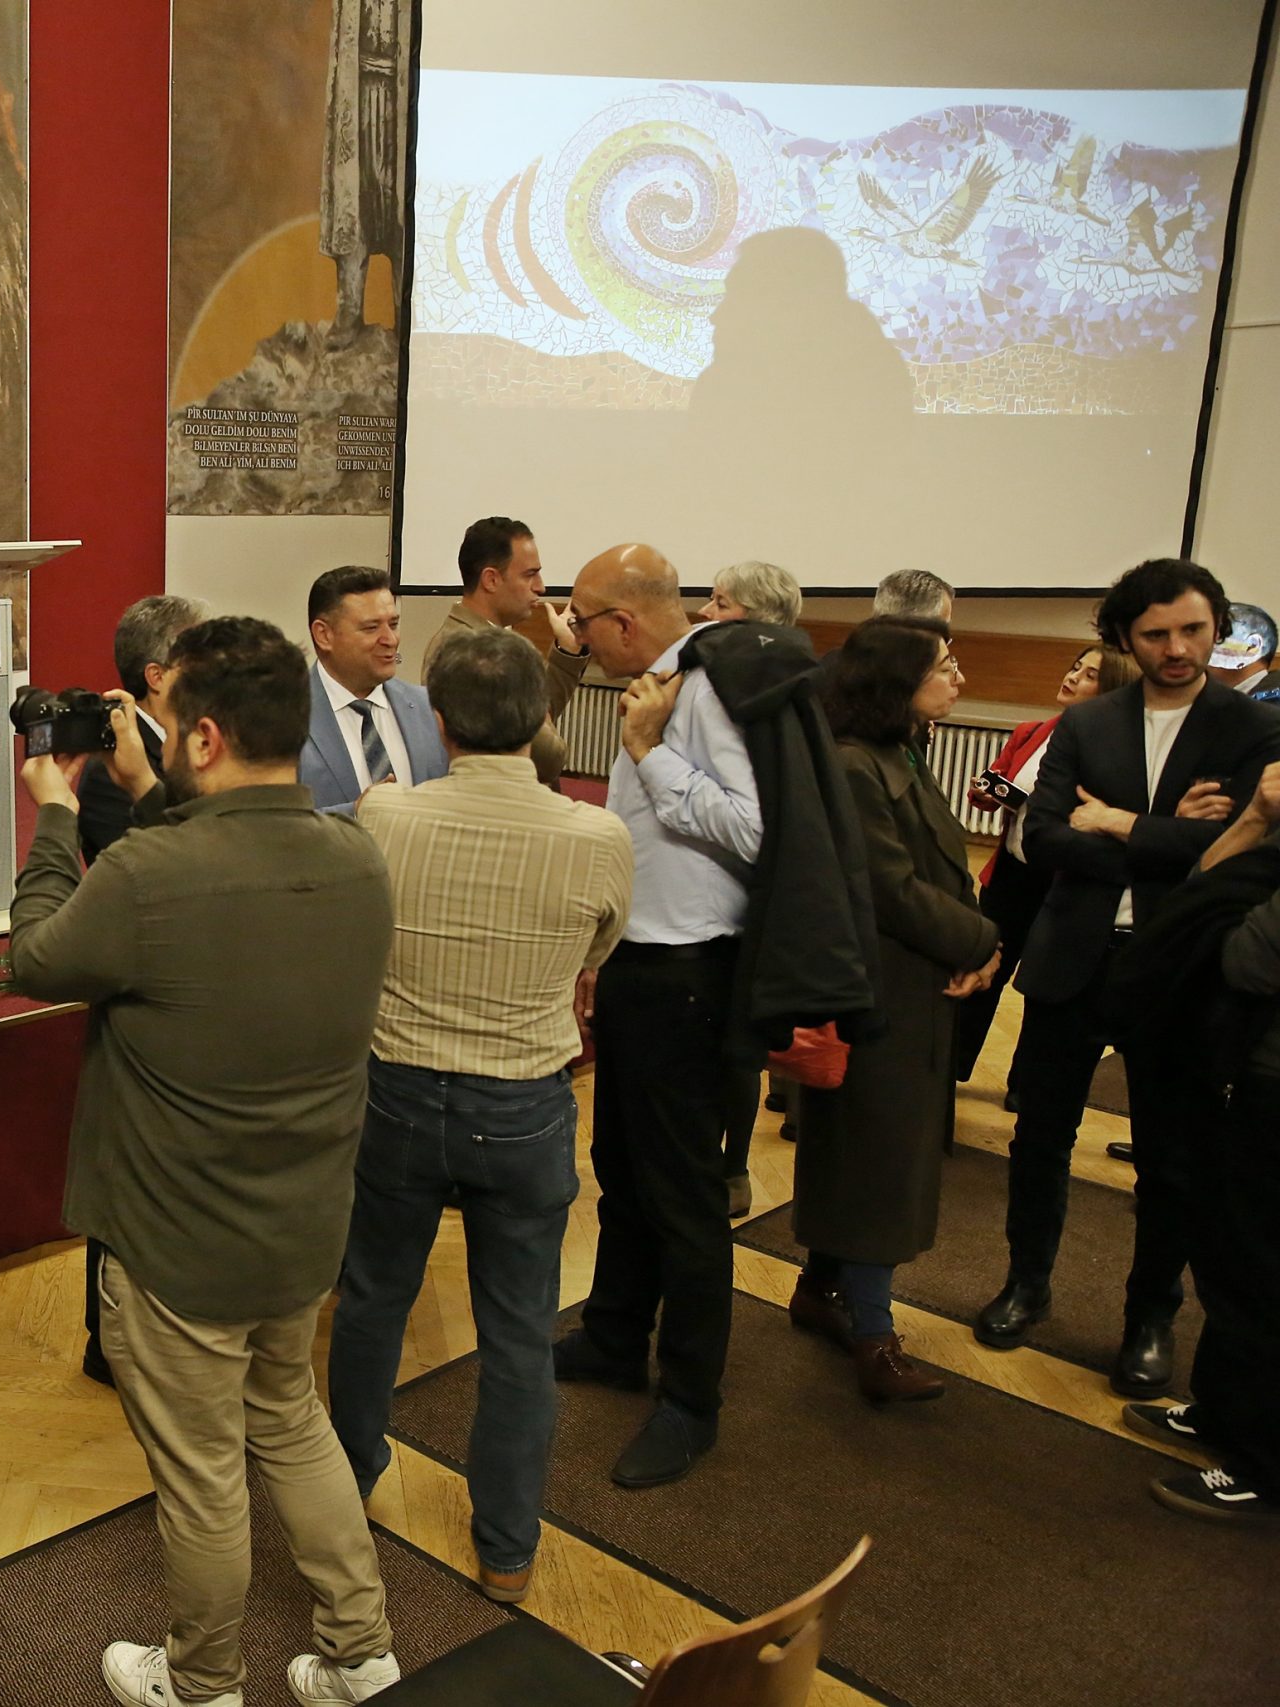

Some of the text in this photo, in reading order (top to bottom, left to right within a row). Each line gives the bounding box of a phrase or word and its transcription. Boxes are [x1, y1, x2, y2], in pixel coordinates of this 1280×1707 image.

[187, 407, 201, 419] PİR
[249, 411, 260, 424] ŞU
[261, 411, 297, 423] DÜNYAYA
[339, 416, 351, 426] PIR
[353, 417, 378, 426] SULTAN
[185, 424, 297, 438] DOLU GELDİM DOLU BENİM
[339, 431, 380, 441] GEKOMMEN
[278, 442, 296, 453] BENİ
[338, 446, 389, 455] UNWISSENDEN
[200, 457, 218, 467] BEN
[255, 457, 268, 468] ALİ
[270, 457, 296, 468] BENİM
[338, 460, 351, 469] ICH
[353, 461, 366, 469] BIN
